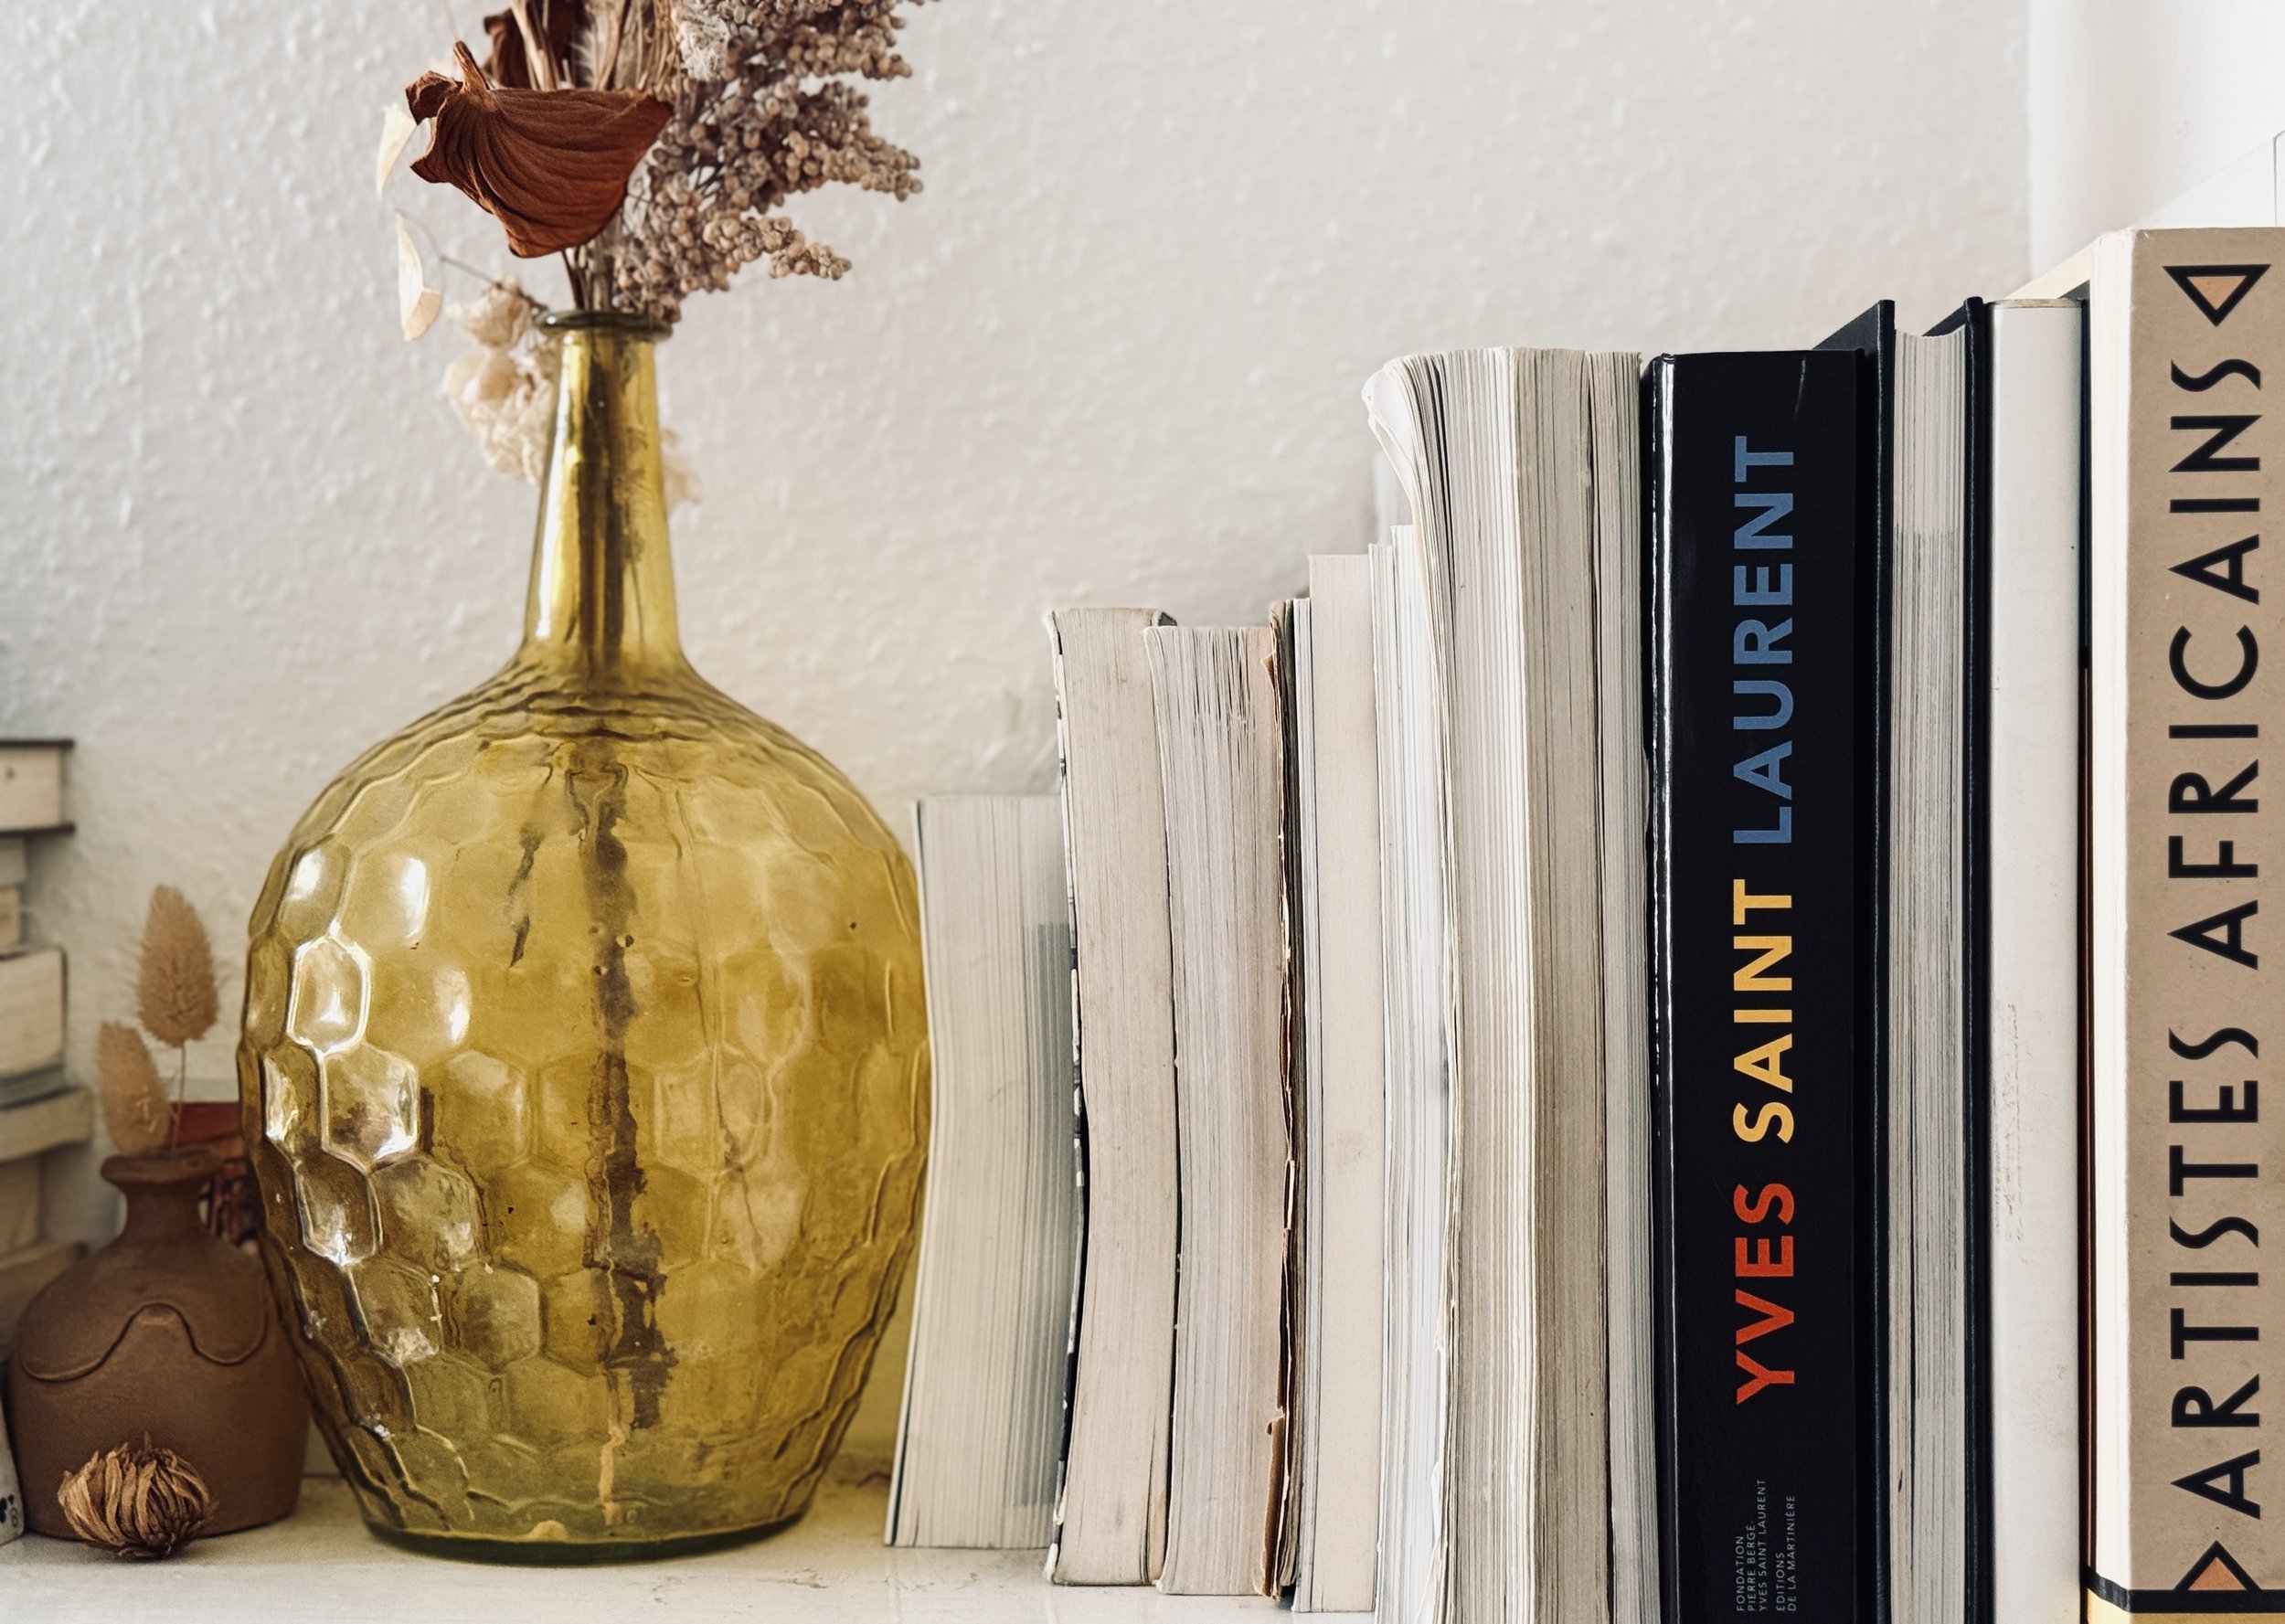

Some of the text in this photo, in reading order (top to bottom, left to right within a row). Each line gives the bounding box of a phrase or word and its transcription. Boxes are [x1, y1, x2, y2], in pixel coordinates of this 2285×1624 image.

[1733, 435, 1794, 1405] YVES SAINT LAURENT
[2167, 358, 2261, 1520] ARTISTES AFRICAINS
[1735, 1535, 1745, 1611] FONDATION
[1747, 1569, 1756, 1611] PIERRE
[1757, 1479, 1767, 1611] YVES SAINT LAURENT
[1785, 1495, 1796, 1611] DE LA MARTINIÈRE
